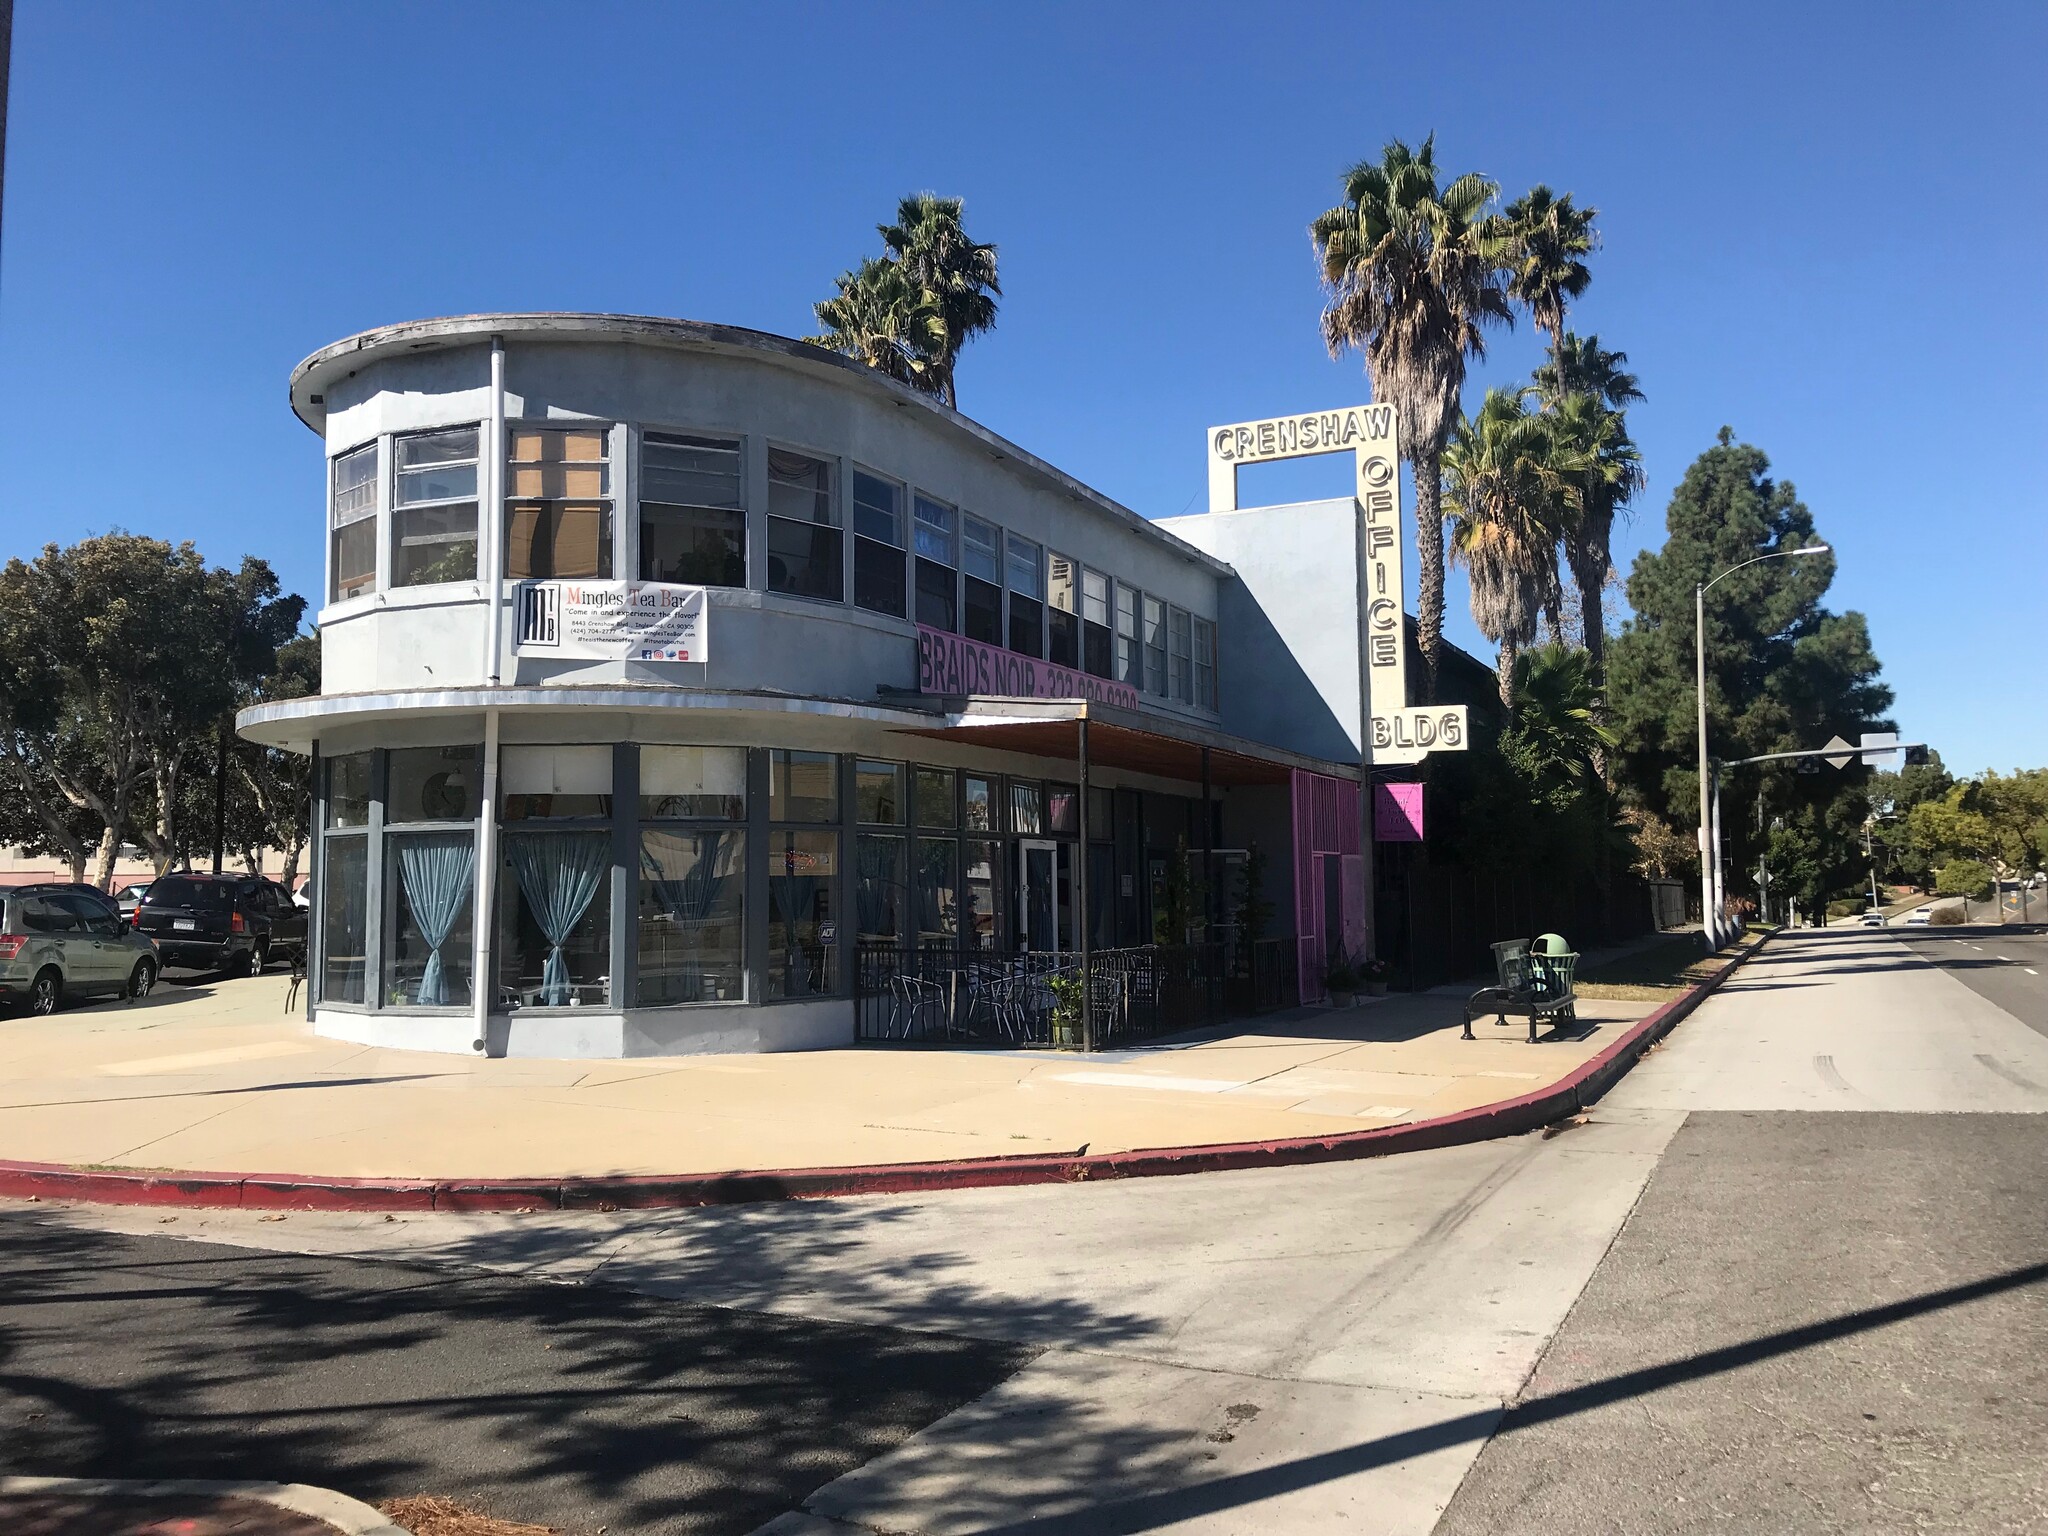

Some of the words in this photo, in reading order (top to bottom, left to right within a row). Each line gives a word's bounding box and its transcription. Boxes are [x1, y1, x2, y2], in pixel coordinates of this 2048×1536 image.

[1214, 406, 1392, 460] CRENSHAW
[1363, 456, 1397, 668] OFFICE
[566, 587, 624, 609] Mingles
[630, 588, 656, 607] Tea
[660, 589, 686, 608] Bar
[565, 608, 588, 616] "Come
[616, 609, 656, 619] experience
[643, 637, 685, 645] #itsnotaboutus
[919, 632, 990, 695] BRAIDS
[995, 653, 1036, 698] NOIR
[1371, 712, 1462, 748] BLDG
[820, 928, 835, 938] ADT
